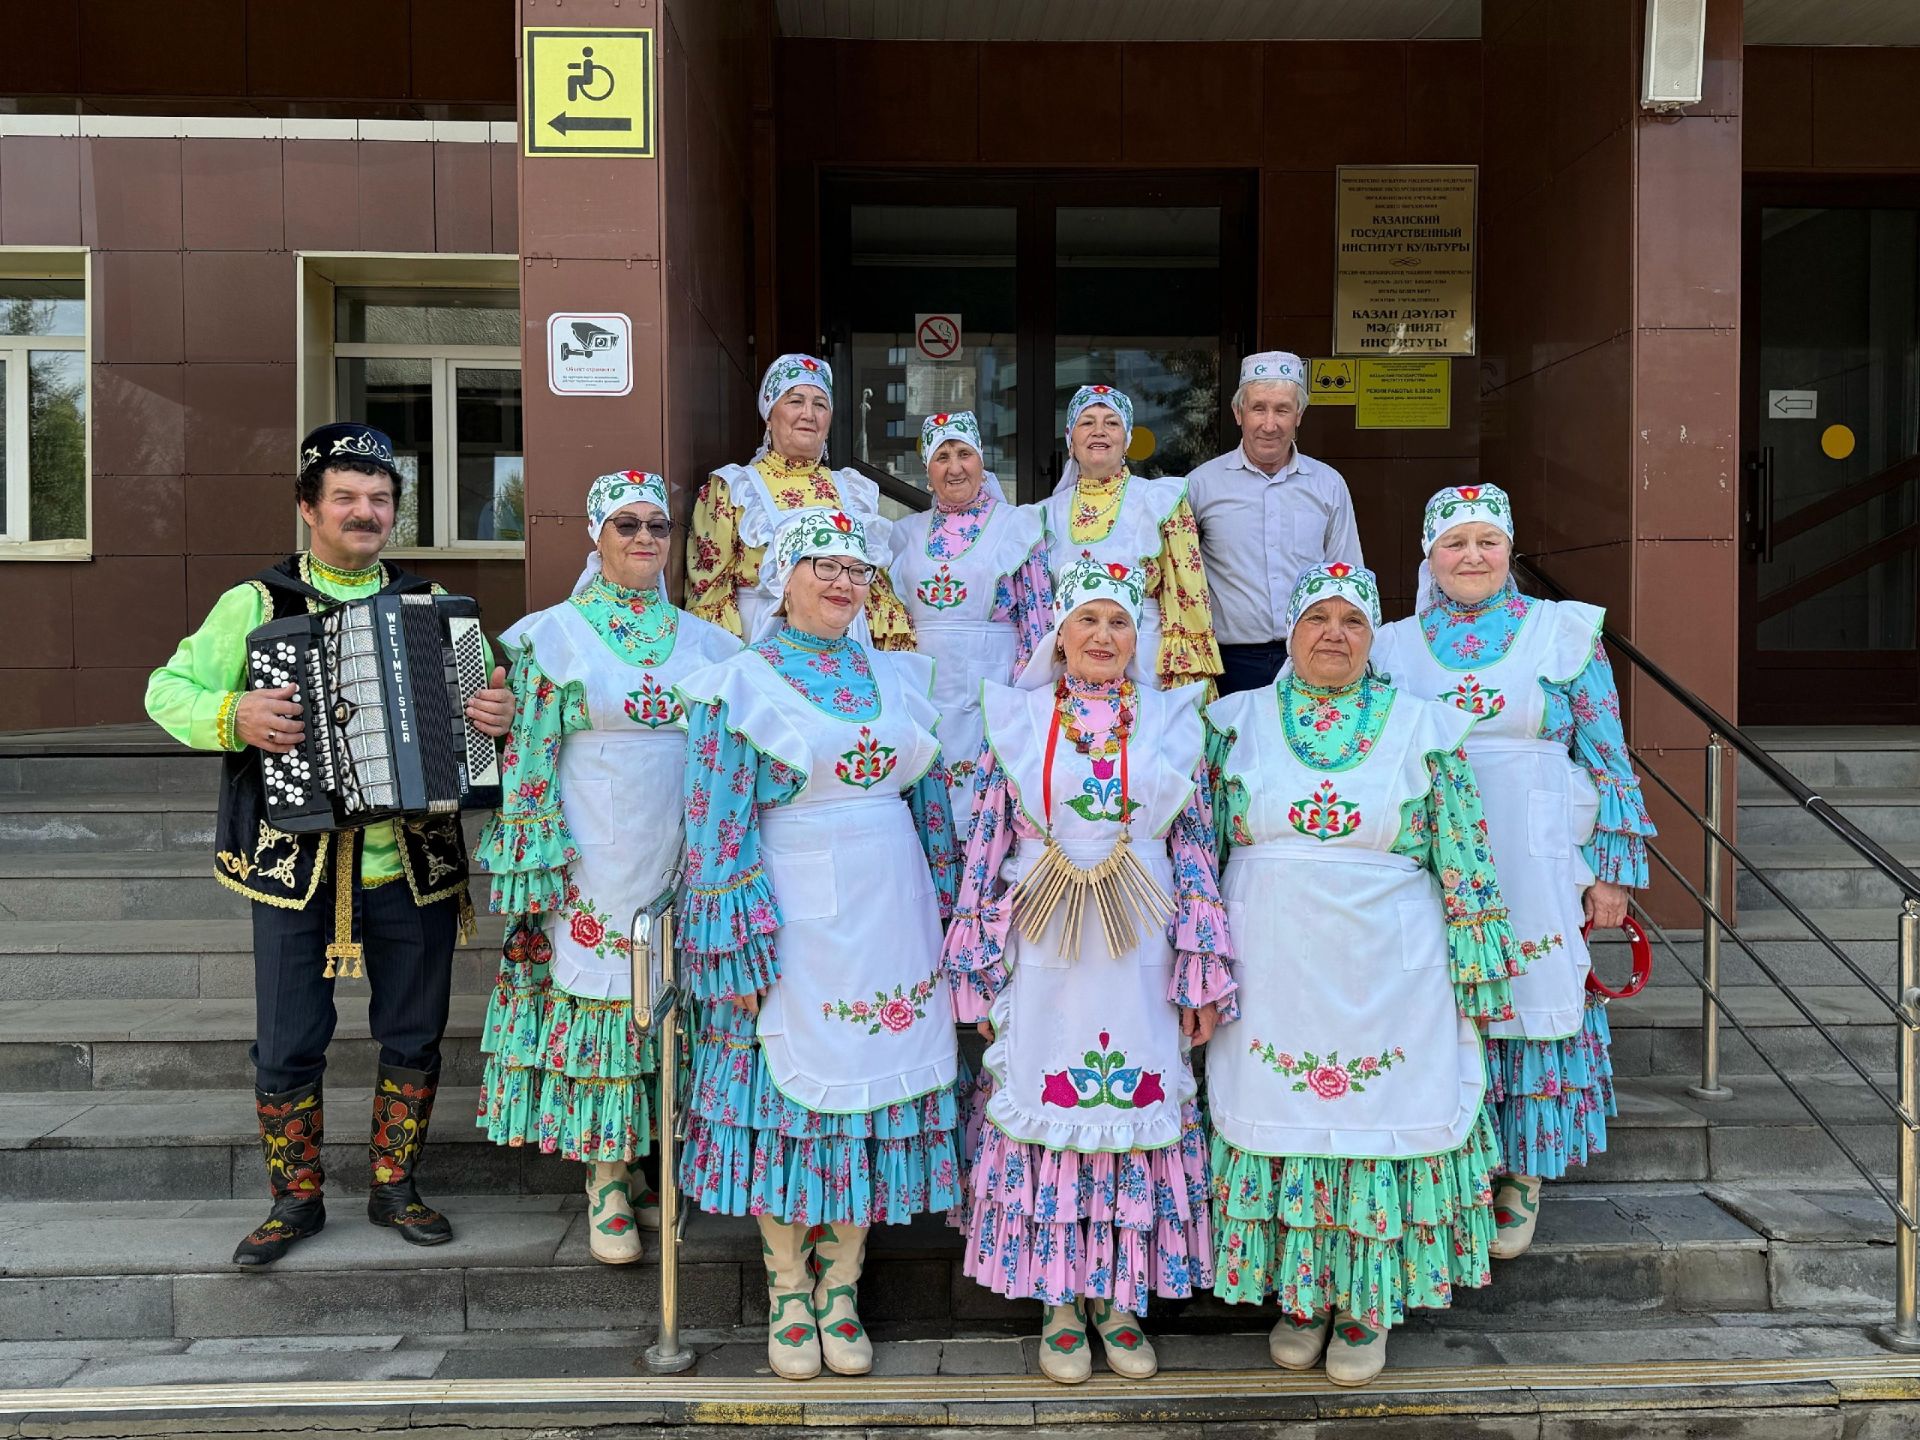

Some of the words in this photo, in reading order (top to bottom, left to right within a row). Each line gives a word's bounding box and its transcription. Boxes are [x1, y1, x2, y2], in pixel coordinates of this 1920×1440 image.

[1372, 214, 1440, 225] КАЗАНСКИЙ
[1351, 227, 1462, 240] ГОСУДАРСТВЕННЫЙ
[1342, 243, 1403, 252] ИНСТИТУТ
[1406, 243, 1470, 253] КУЛЬТУРЫ
[1352, 309, 1398, 319] КАЗАН
[385, 612, 411, 743] WELTMEISTER
